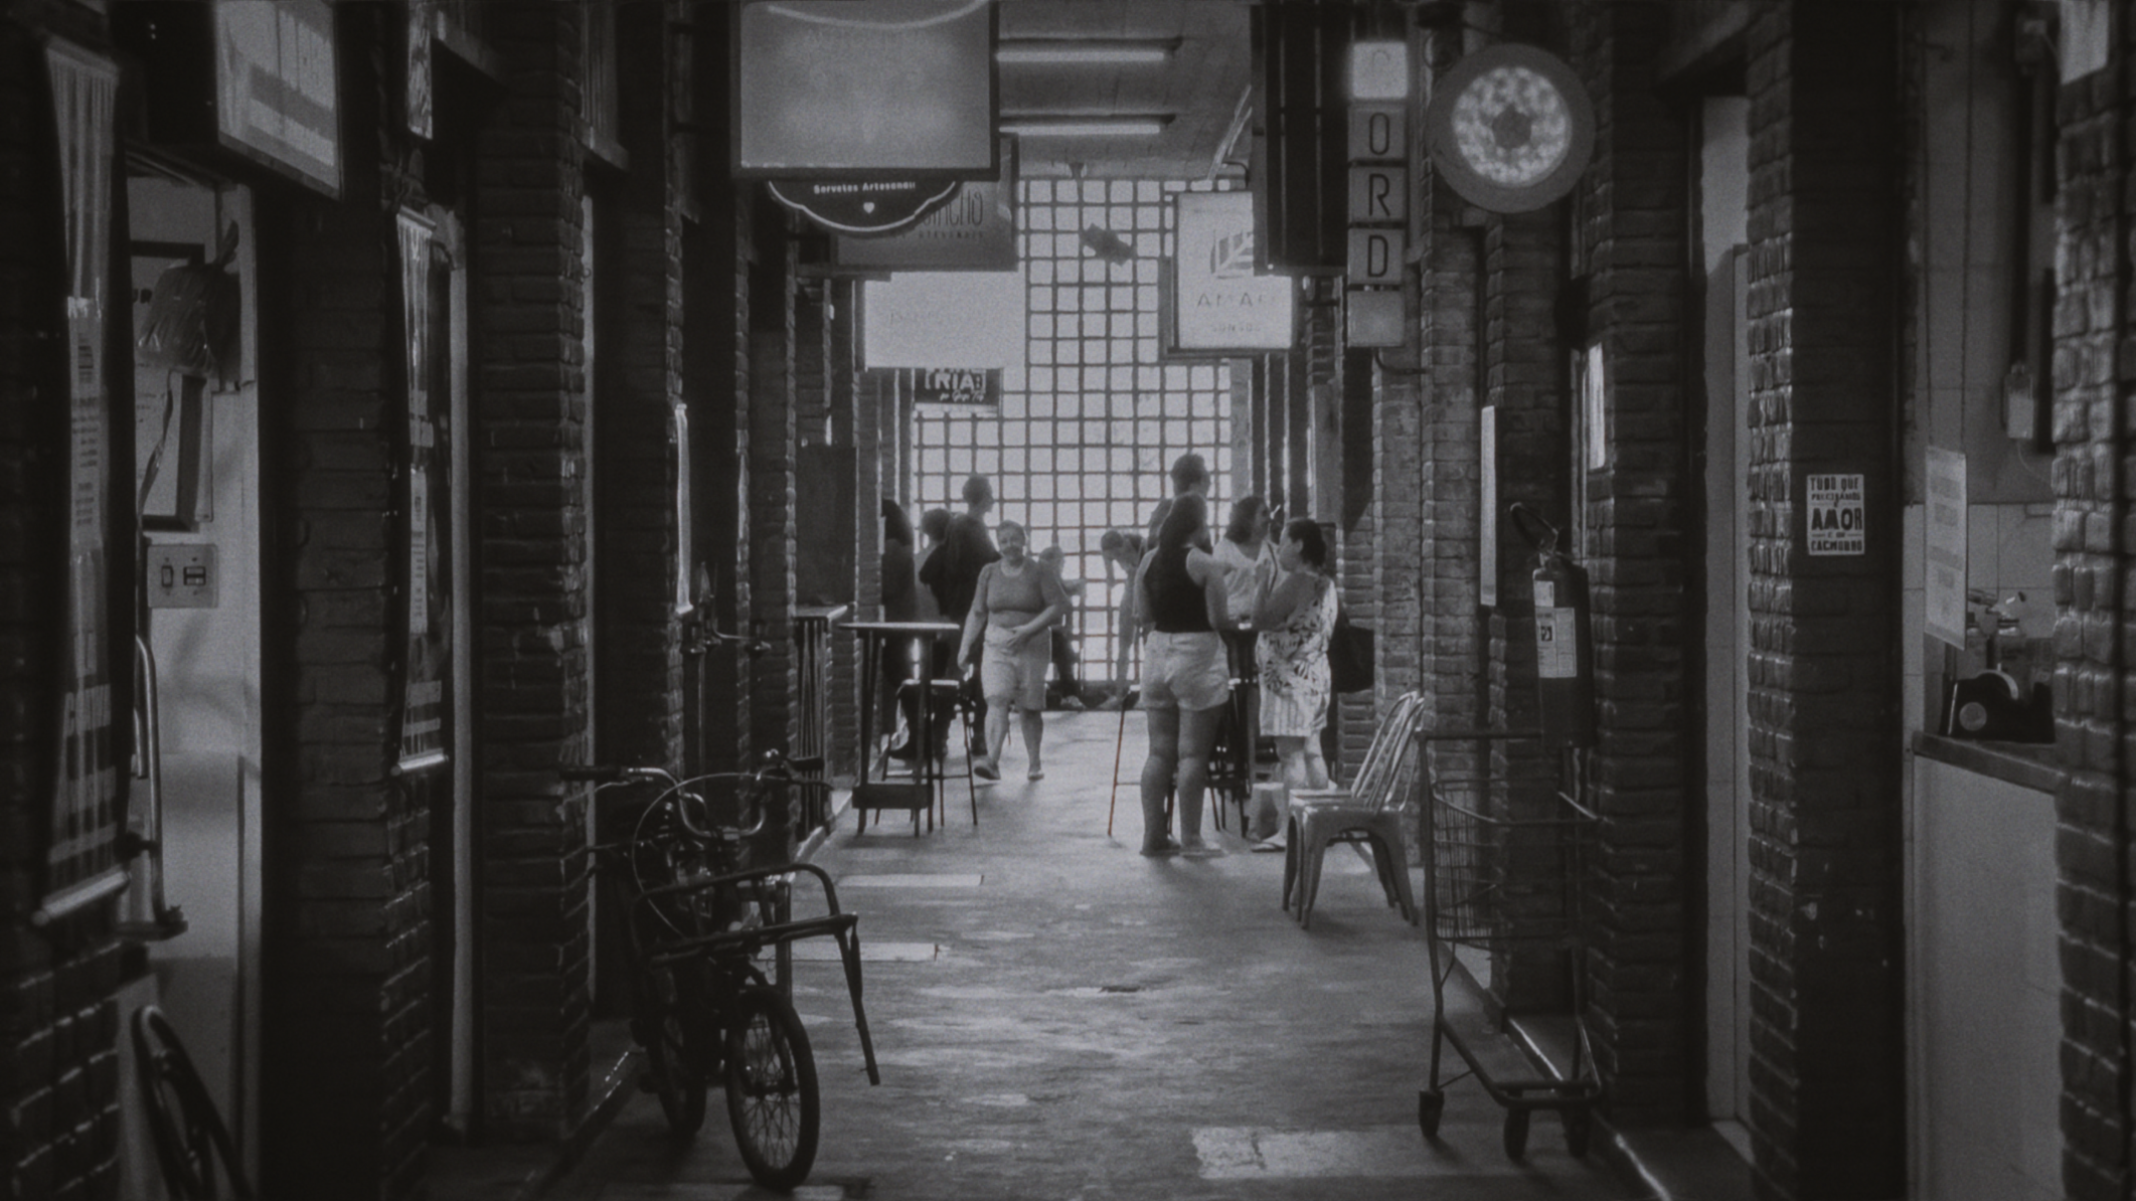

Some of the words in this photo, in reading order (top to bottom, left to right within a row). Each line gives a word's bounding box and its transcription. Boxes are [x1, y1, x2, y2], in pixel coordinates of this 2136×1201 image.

[813, 183, 859, 195] Sorvetes
[1811, 477, 1836, 491] TUDO
[1841, 478, 1859, 492] QUE
[1811, 507, 1863, 530] AMOR
[1811, 540, 1863, 551] CACHORRO
